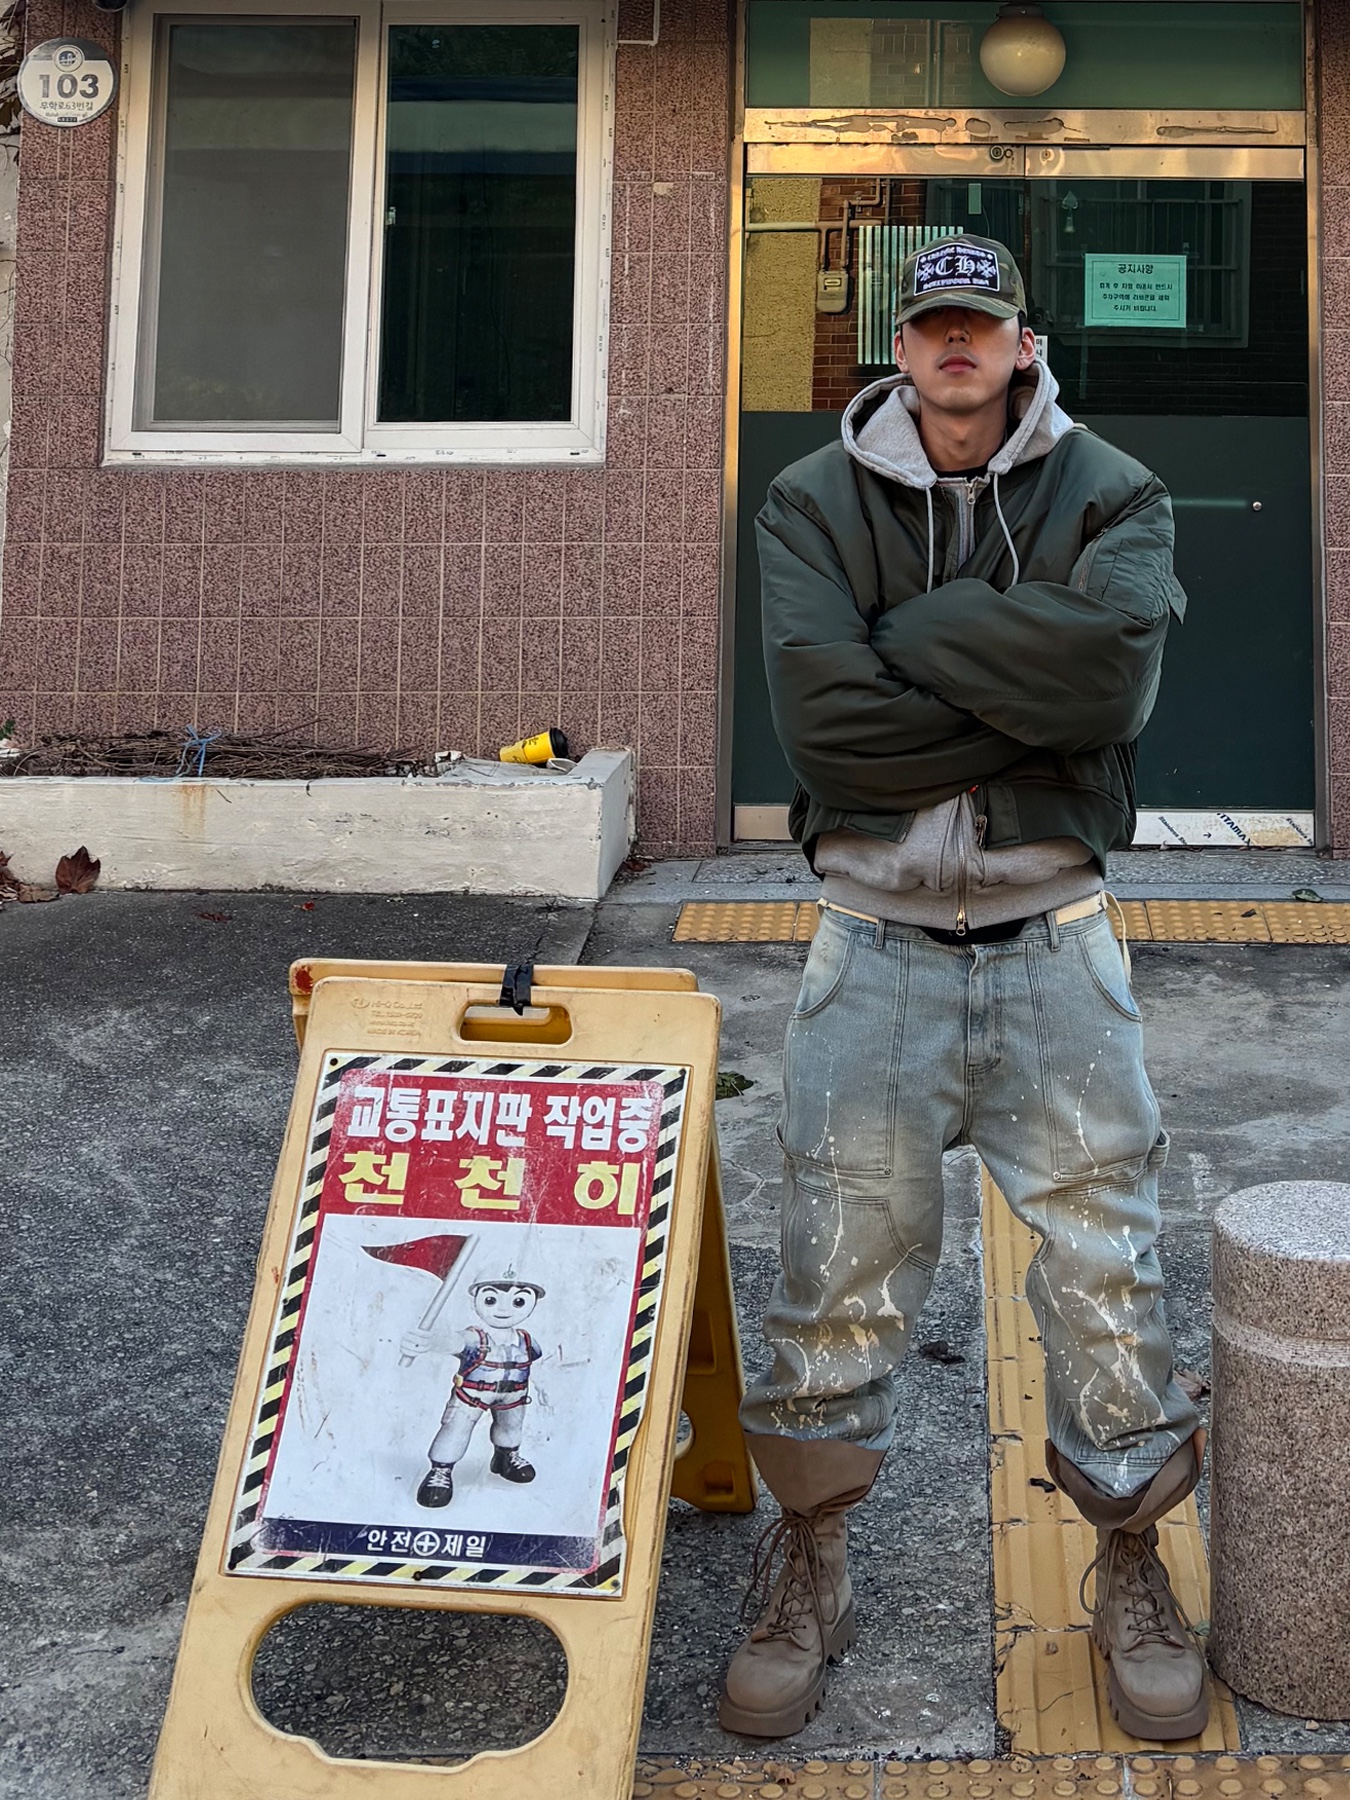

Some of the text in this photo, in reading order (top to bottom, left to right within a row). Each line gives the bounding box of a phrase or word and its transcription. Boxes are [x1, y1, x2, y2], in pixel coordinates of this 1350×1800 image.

[39, 73, 99, 99] 103
[935, 255, 976, 276] CH
[1118, 263, 1154, 274] 공지사항
[347, 1086, 652, 1153] 교통표지판 작업중
[338, 1151, 642, 1216] 천 천 히
[367, 1529, 487, 1558] 안전 제일
